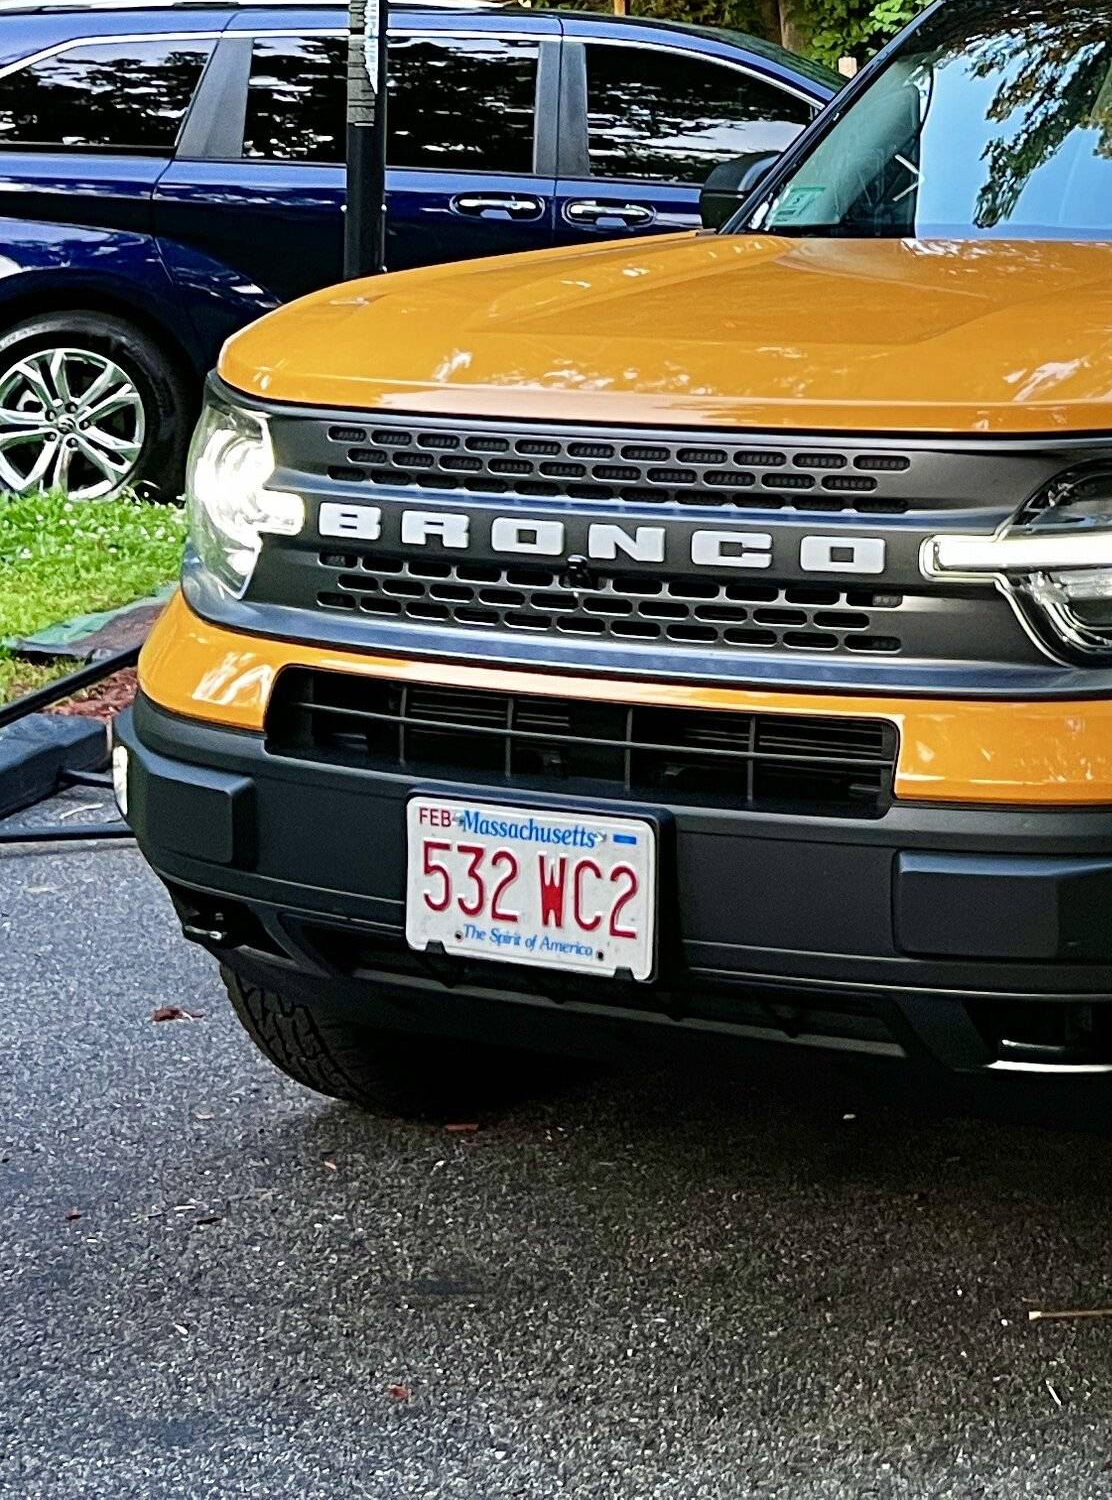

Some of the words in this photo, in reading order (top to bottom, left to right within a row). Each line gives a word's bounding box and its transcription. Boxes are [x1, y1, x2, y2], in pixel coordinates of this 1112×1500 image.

[319, 501, 886, 575] BRONCO
[419, 807, 451, 828] FEB
[462, 809, 597, 848] Massachusetts
[423, 840, 519, 924] 532
[538, 852, 638, 940] WC2
[464, 923, 486, 941] The
[489, 927, 521, 946] Spirit
[525, 934, 538, 951] of
[540, 936, 593, 957] America
